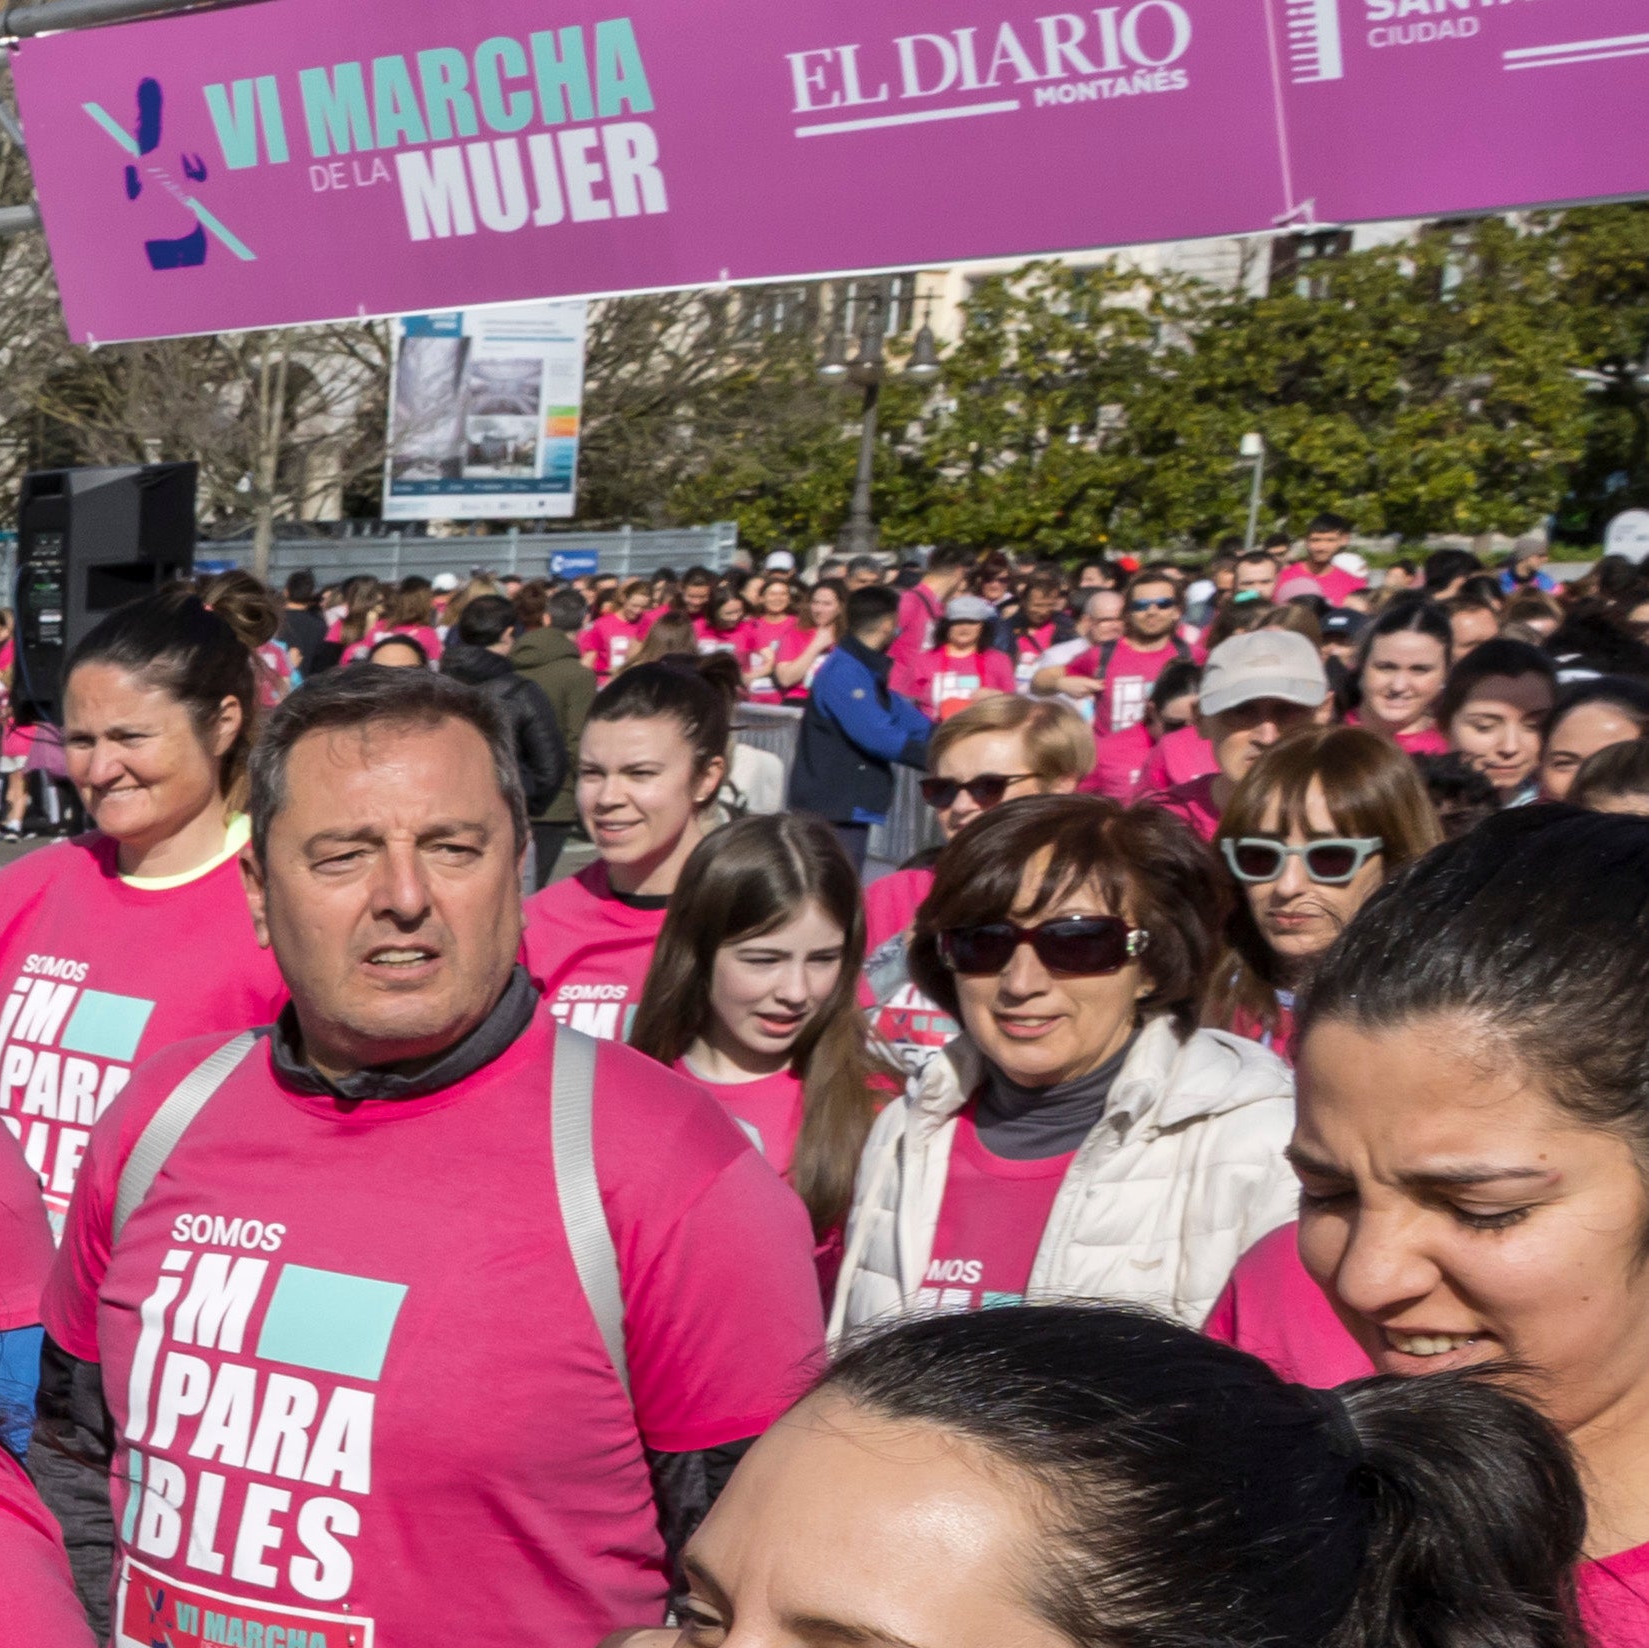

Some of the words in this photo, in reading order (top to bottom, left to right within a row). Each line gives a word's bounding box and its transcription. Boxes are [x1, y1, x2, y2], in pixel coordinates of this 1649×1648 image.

[1367, 16, 1481, 48] CIUDAD
[784, 44, 890, 113] EL
[892, 0, 1193, 98] DIARIO
[203, 75, 290, 170] VI
[299, 17, 656, 158] MARCHA
[1032, 66, 1190, 108] MONTAÑÉS
[308, 162, 349, 192] DE
[351, 157, 392, 187] LA
[395, 121, 669, 241] MUJER
[557, 984, 629, 1001] SOMOS
[170, 1213, 287, 1252] SOMOS
[925, 1258, 984, 1285] MOS
[150, 1351, 375, 1495] PARA
[137, 1456, 362, 1602] BLES
[175, 1600, 199, 1637] VI
